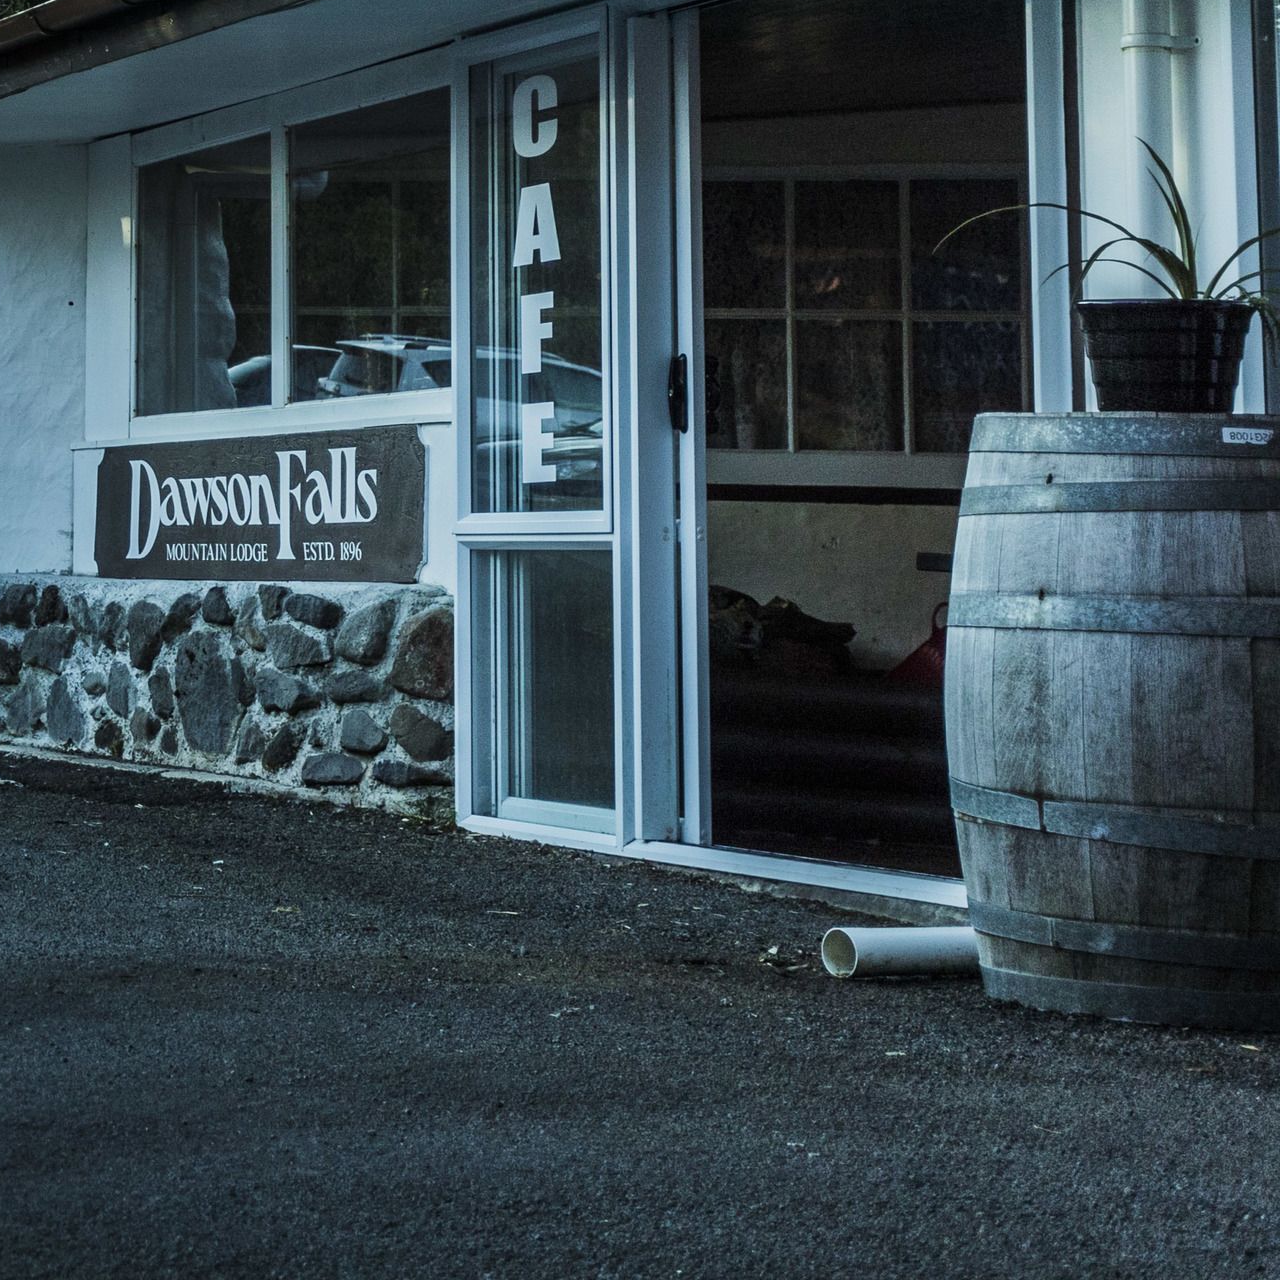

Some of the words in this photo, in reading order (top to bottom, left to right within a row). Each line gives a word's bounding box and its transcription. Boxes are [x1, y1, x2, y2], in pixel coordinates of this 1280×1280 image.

[512, 74, 561, 484] CAFE
[125, 459, 280, 560] Dawson
[275, 447, 378, 560] Falls
[166, 543, 227, 561] MOUNTAIN
[230, 543, 269, 562] LODGE
[303, 541, 336, 561] ESTD.
[340, 541, 363, 561] 1896
